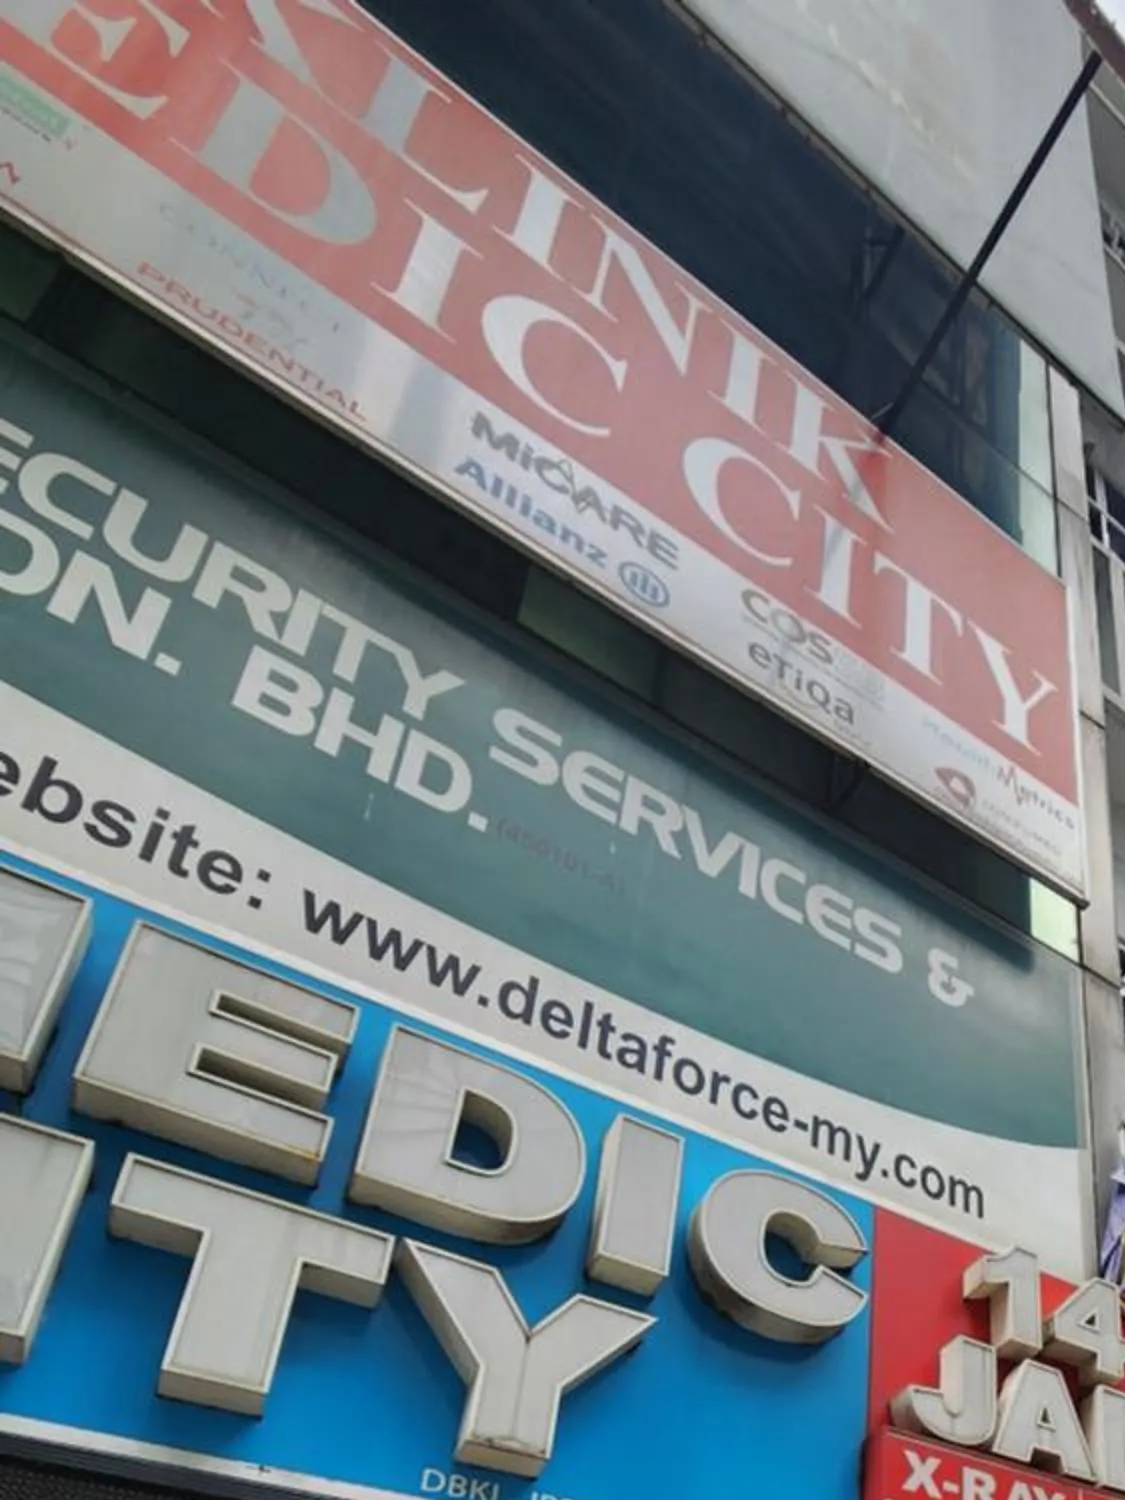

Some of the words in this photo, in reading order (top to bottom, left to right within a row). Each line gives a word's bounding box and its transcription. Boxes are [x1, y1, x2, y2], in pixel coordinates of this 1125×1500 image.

[137, 261, 368, 423] PRUDENTIAL
[453, 455, 609, 570] Allianz
[682, 436, 1059, 757] CITY
[231, 646, 489, 833] BHD.
[489, 706, 903, 973] SERVICES
[926, 947, 976, 1007] &
[303, 888, 985, 1220] www.deltaforce-my.com
